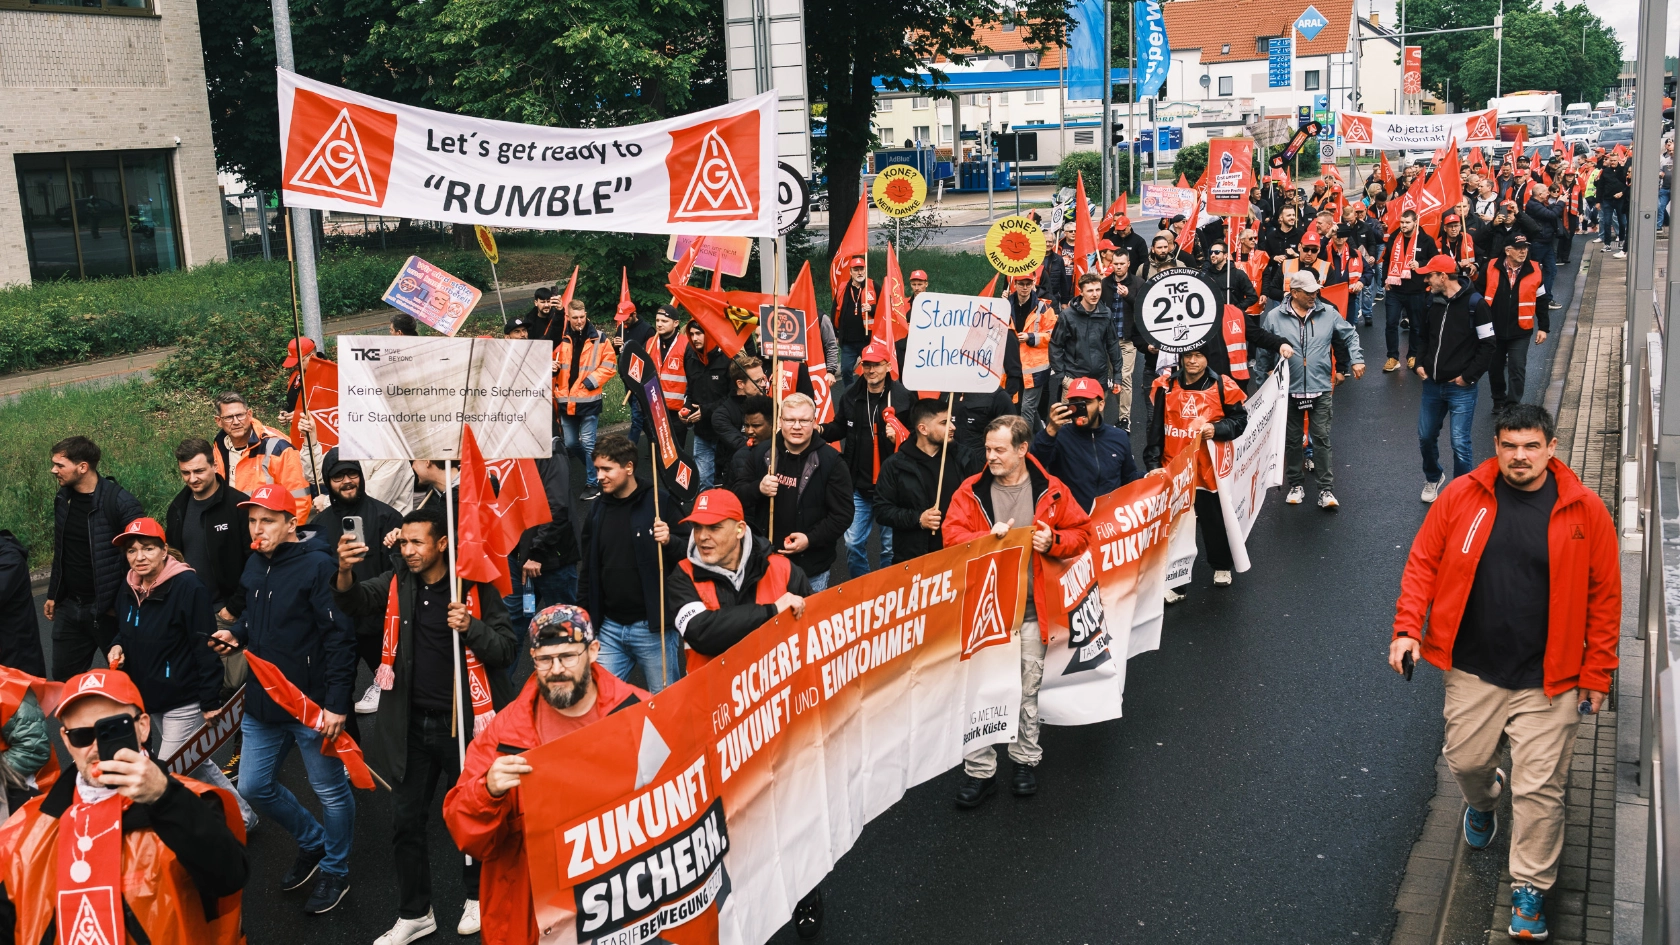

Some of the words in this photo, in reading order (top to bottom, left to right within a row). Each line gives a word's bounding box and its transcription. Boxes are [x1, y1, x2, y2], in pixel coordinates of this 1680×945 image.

[1298, 19, 1322, 28] ARAL
[1388, 124, 1402, 133] Ab
[1404, 124, 1428, 134] jetzt
[1432, 124, 1444, 132] ist
[498, 140, 537, 165] get
[541, 139, 607, 164] ready
[613, 140, 643, 158] to
[888, 155, 912, 163] AdBlue
[883, 167, 917, 180] KONE?
[876, 197, 893, 214] NEIN
[894, 200, 921, 215] DANKE
[999, 219, 1037, 234] KONE?
[723, 248, 737, 256] nicht
[989, 251, 1007, 271] NEIN
[1008, 258, 1038, 274] DANKE
[1152, 271, 1169, 282] TEAM
[1170, 269, 1199, 277] ZUKUNFT
[1165, 282, 1189, 294] TKE
[1172, 296, 1184, 304] TV
[1152, 293, 1205, 324] 2.0
[1160, 344, 1176, 352] TEAM
[1183, 340, 1206, 352] METALL
[351, 348, 380, 361] TKE
[916, 336, 993, 378] sicherung
[348, 386, 382, 396] Keine
[386, 384, 456, 396] Übernahme
[460, 386, 488, 397] ohne
[491, 386, 544, 398] Sicherheit
[348, 412, 363, 422] für
[368, 412, 426, 422] Standorte
[430, 412, 452, 422] und
[456, 412, 527, 424] Beschäftigte!
[1096, 522, 1116, 541] FÜR
[712, 706, 732, 735] FÜR
[731, 634, 800, 717] SICHERE
[806, 570, 957, 664] ARBEITSPLÄTZE,
[716, 686, 792, 784] ZUKUNFT
[795, 686, 819, 715] UND
[822, 614, 926, 700] EINKOMMEN
[978, 704, 1008, 722] METALL
[168, 692, 246, 777] UKUNF
[982, 720, 1008, 737] Küste
[564, 754, 708, 879] ZUKUNFT
[582, 810, 726, 933] SICHERN.
